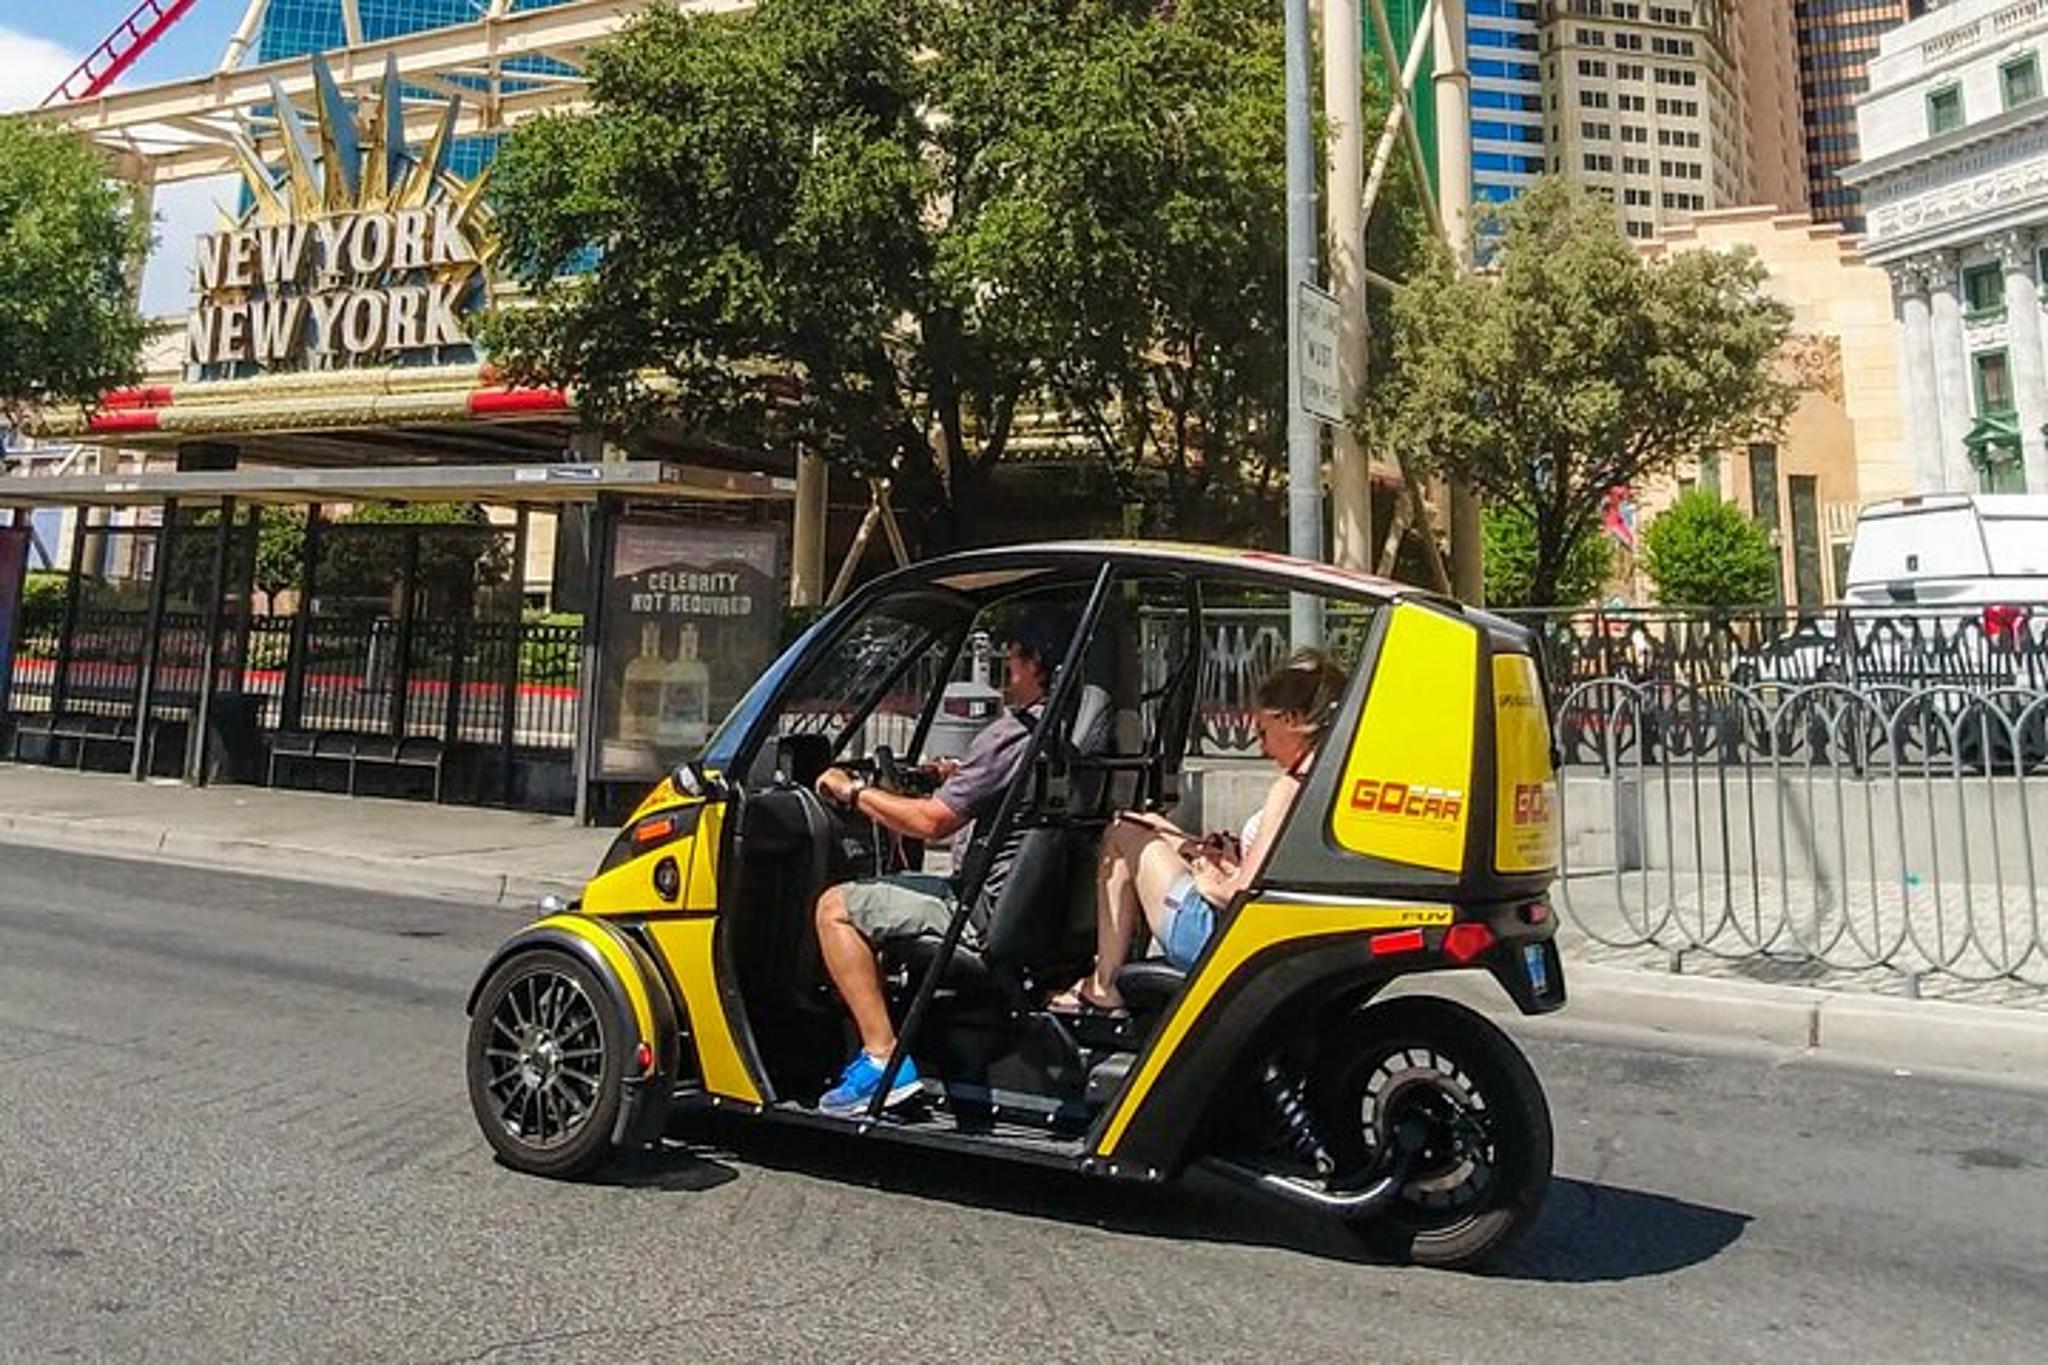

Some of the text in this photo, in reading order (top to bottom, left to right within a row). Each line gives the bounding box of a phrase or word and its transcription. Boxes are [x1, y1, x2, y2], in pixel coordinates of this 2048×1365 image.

[196, 203, 475, 290] NEW YORK
[187, 281, 469, 364] NEW YORK
[631, 593, 752, 615] NOT REQUIRED
[648, 571, 740, 592] CELEBRITY
